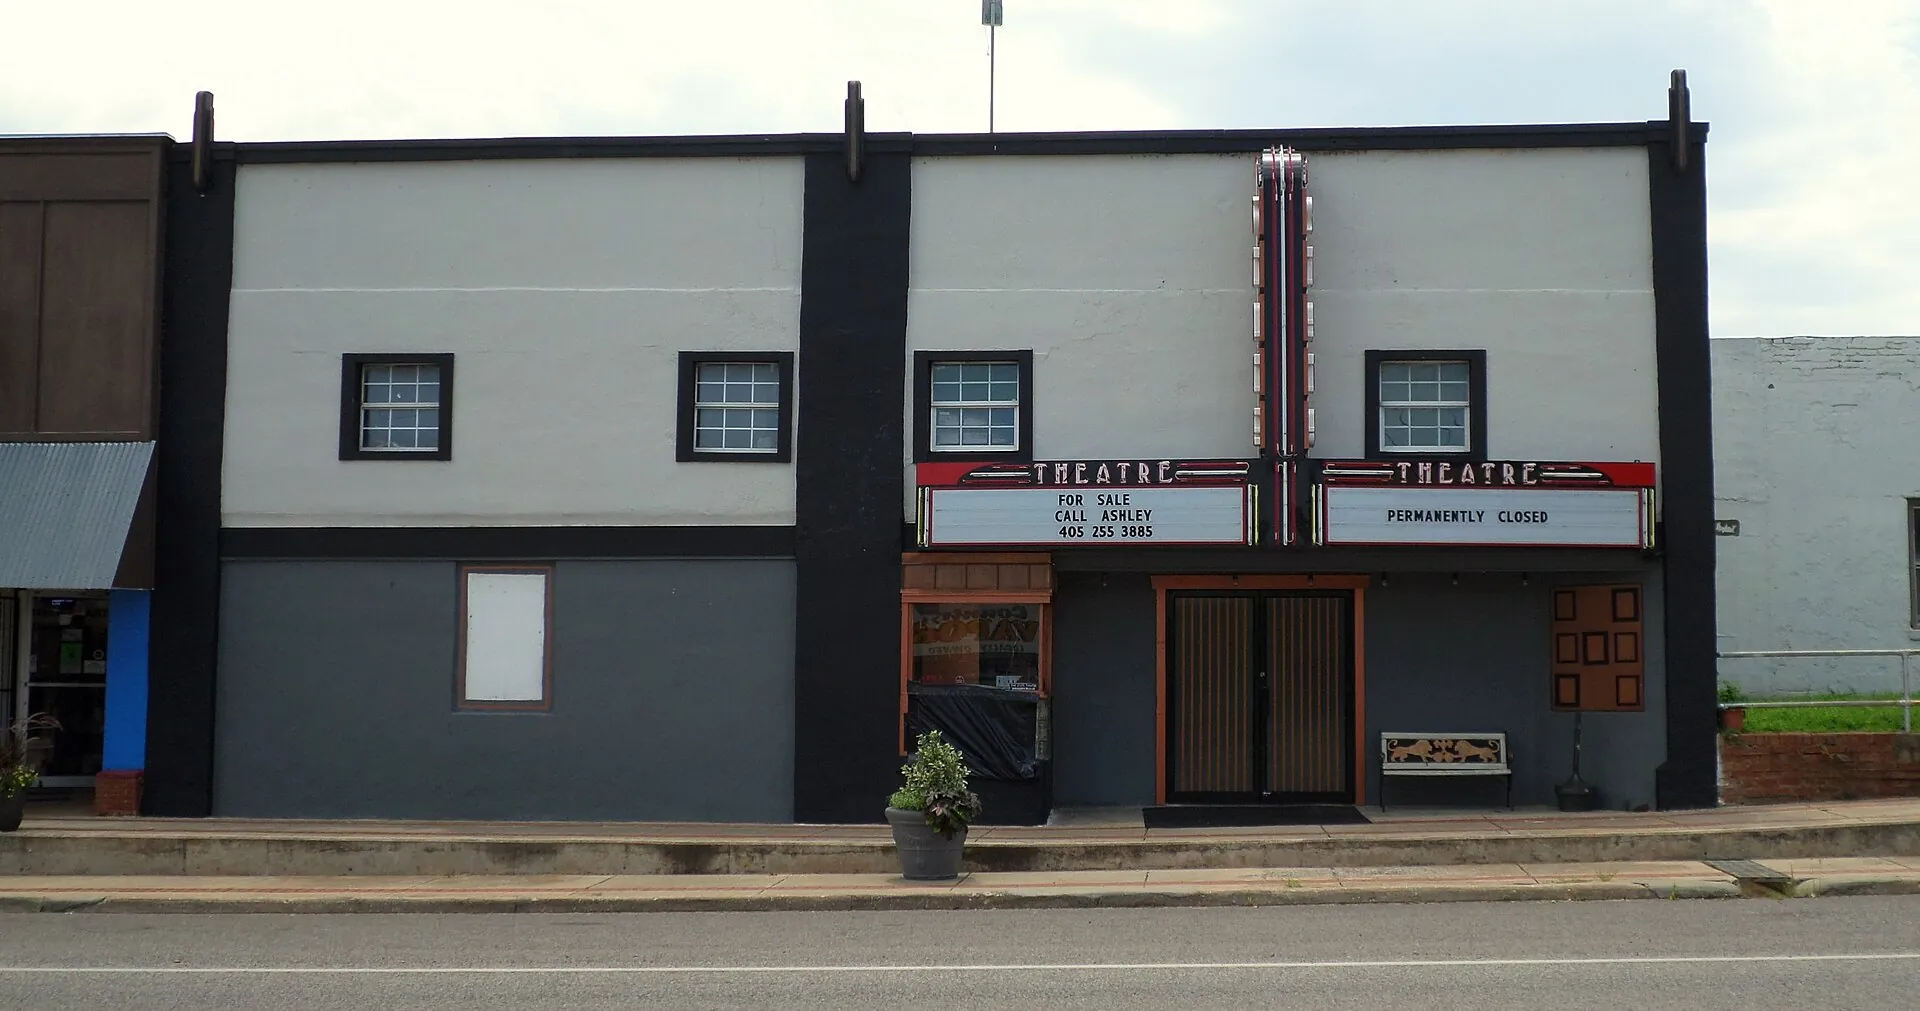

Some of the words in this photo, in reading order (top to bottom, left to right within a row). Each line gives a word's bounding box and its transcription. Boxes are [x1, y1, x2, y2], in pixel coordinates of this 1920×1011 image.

[1033, 461, 1173, 485] THEATRE
[1397, 462, 1537, 485] THEATRE
[1058, 494, 1083, 506] FOR
[1097, 494, 1130, 506] SALE
[1055, 510, 1087, 522] CALL
[1101, 509, 1152, 522] ASHLEY
[1388, 510, 1485, 522] PERMANENTLY
[1498, 511, 1548, 523] CLOSED
[1059, 526, 1084, 538] 405
[1092, 526, 1114, 538] 255
[1121, 526, 1153, 538] 3885
